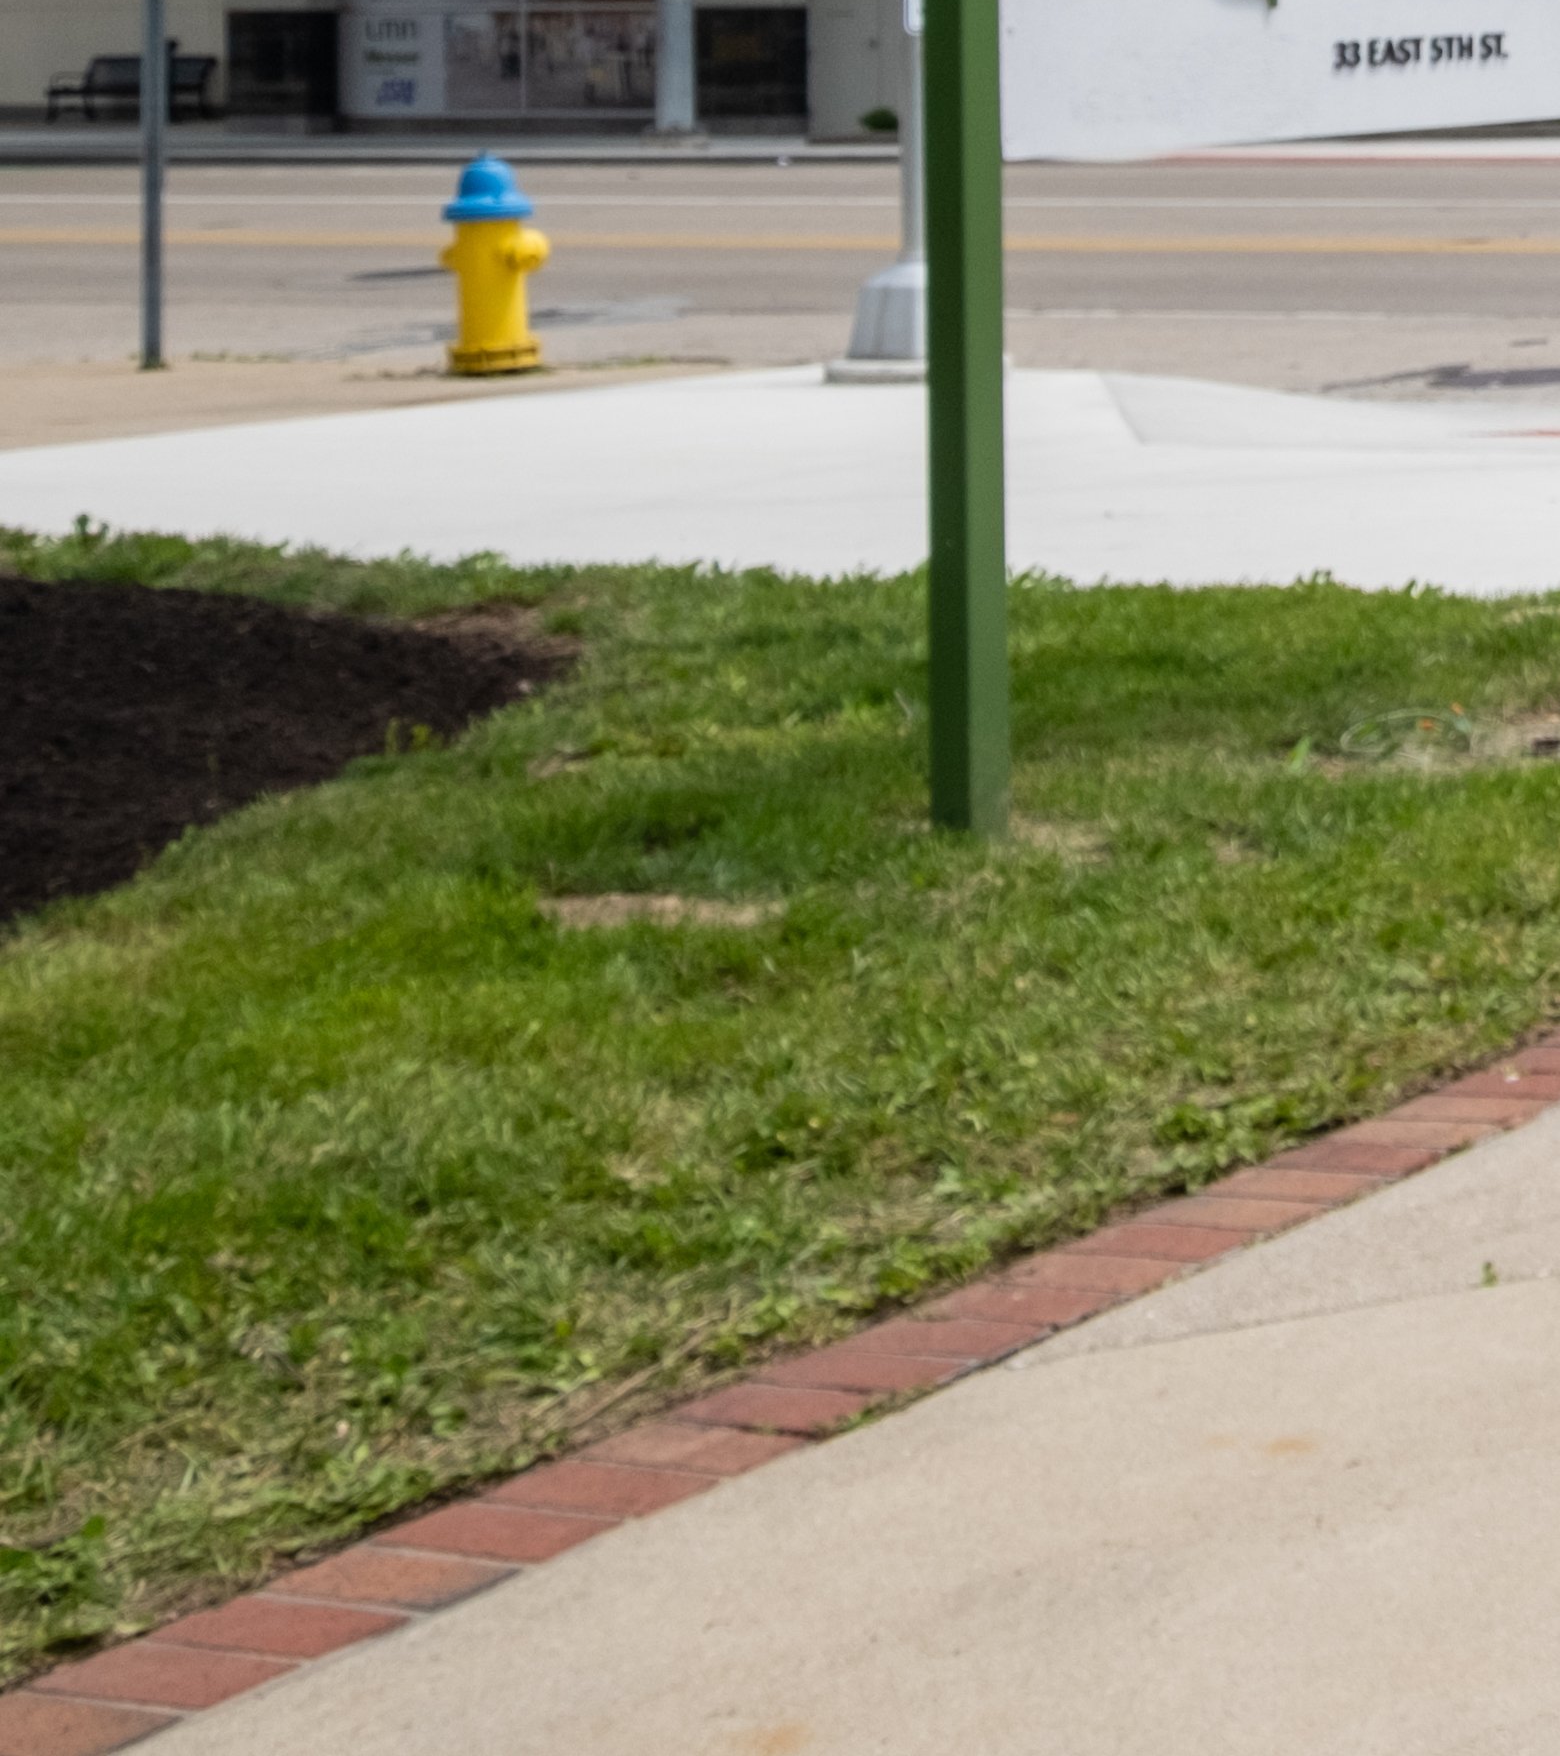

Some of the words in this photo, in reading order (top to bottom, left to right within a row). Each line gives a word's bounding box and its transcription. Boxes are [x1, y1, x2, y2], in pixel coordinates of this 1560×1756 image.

[1335, 41, 1361, 69] 33
[1367, 37, 1423, 66] EAST
[1430, 34, 1474, 62] 5TH
[1480, 32, 1508, 59] ST.
